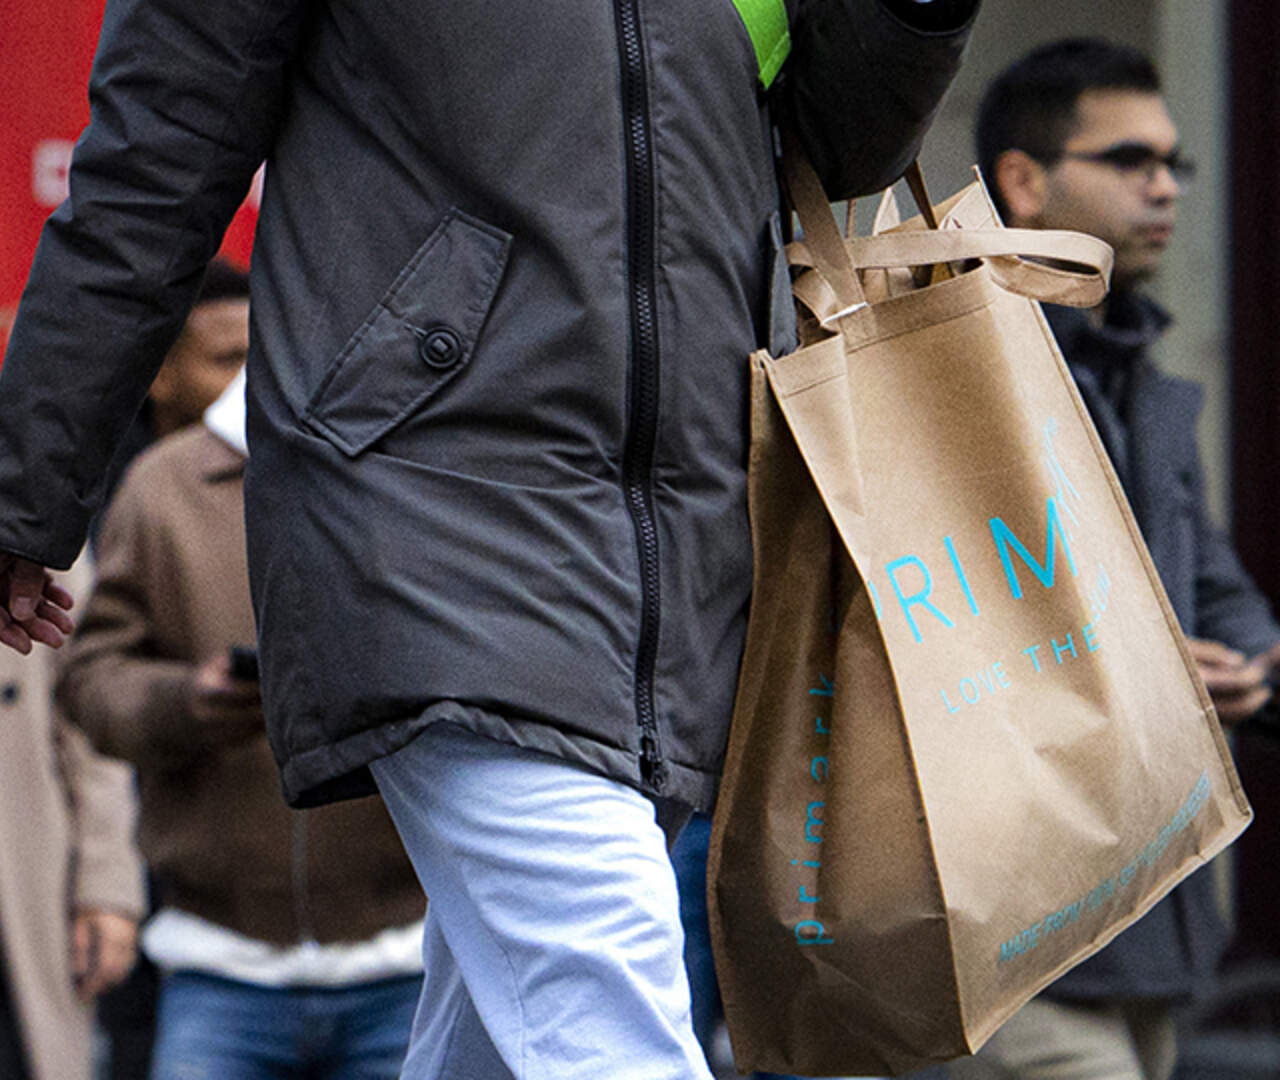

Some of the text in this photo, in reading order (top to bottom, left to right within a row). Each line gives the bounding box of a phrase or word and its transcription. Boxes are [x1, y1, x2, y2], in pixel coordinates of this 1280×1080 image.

[940, 622, 1101, 714] LOVE THE
[794, 672, 835, 946] primark
